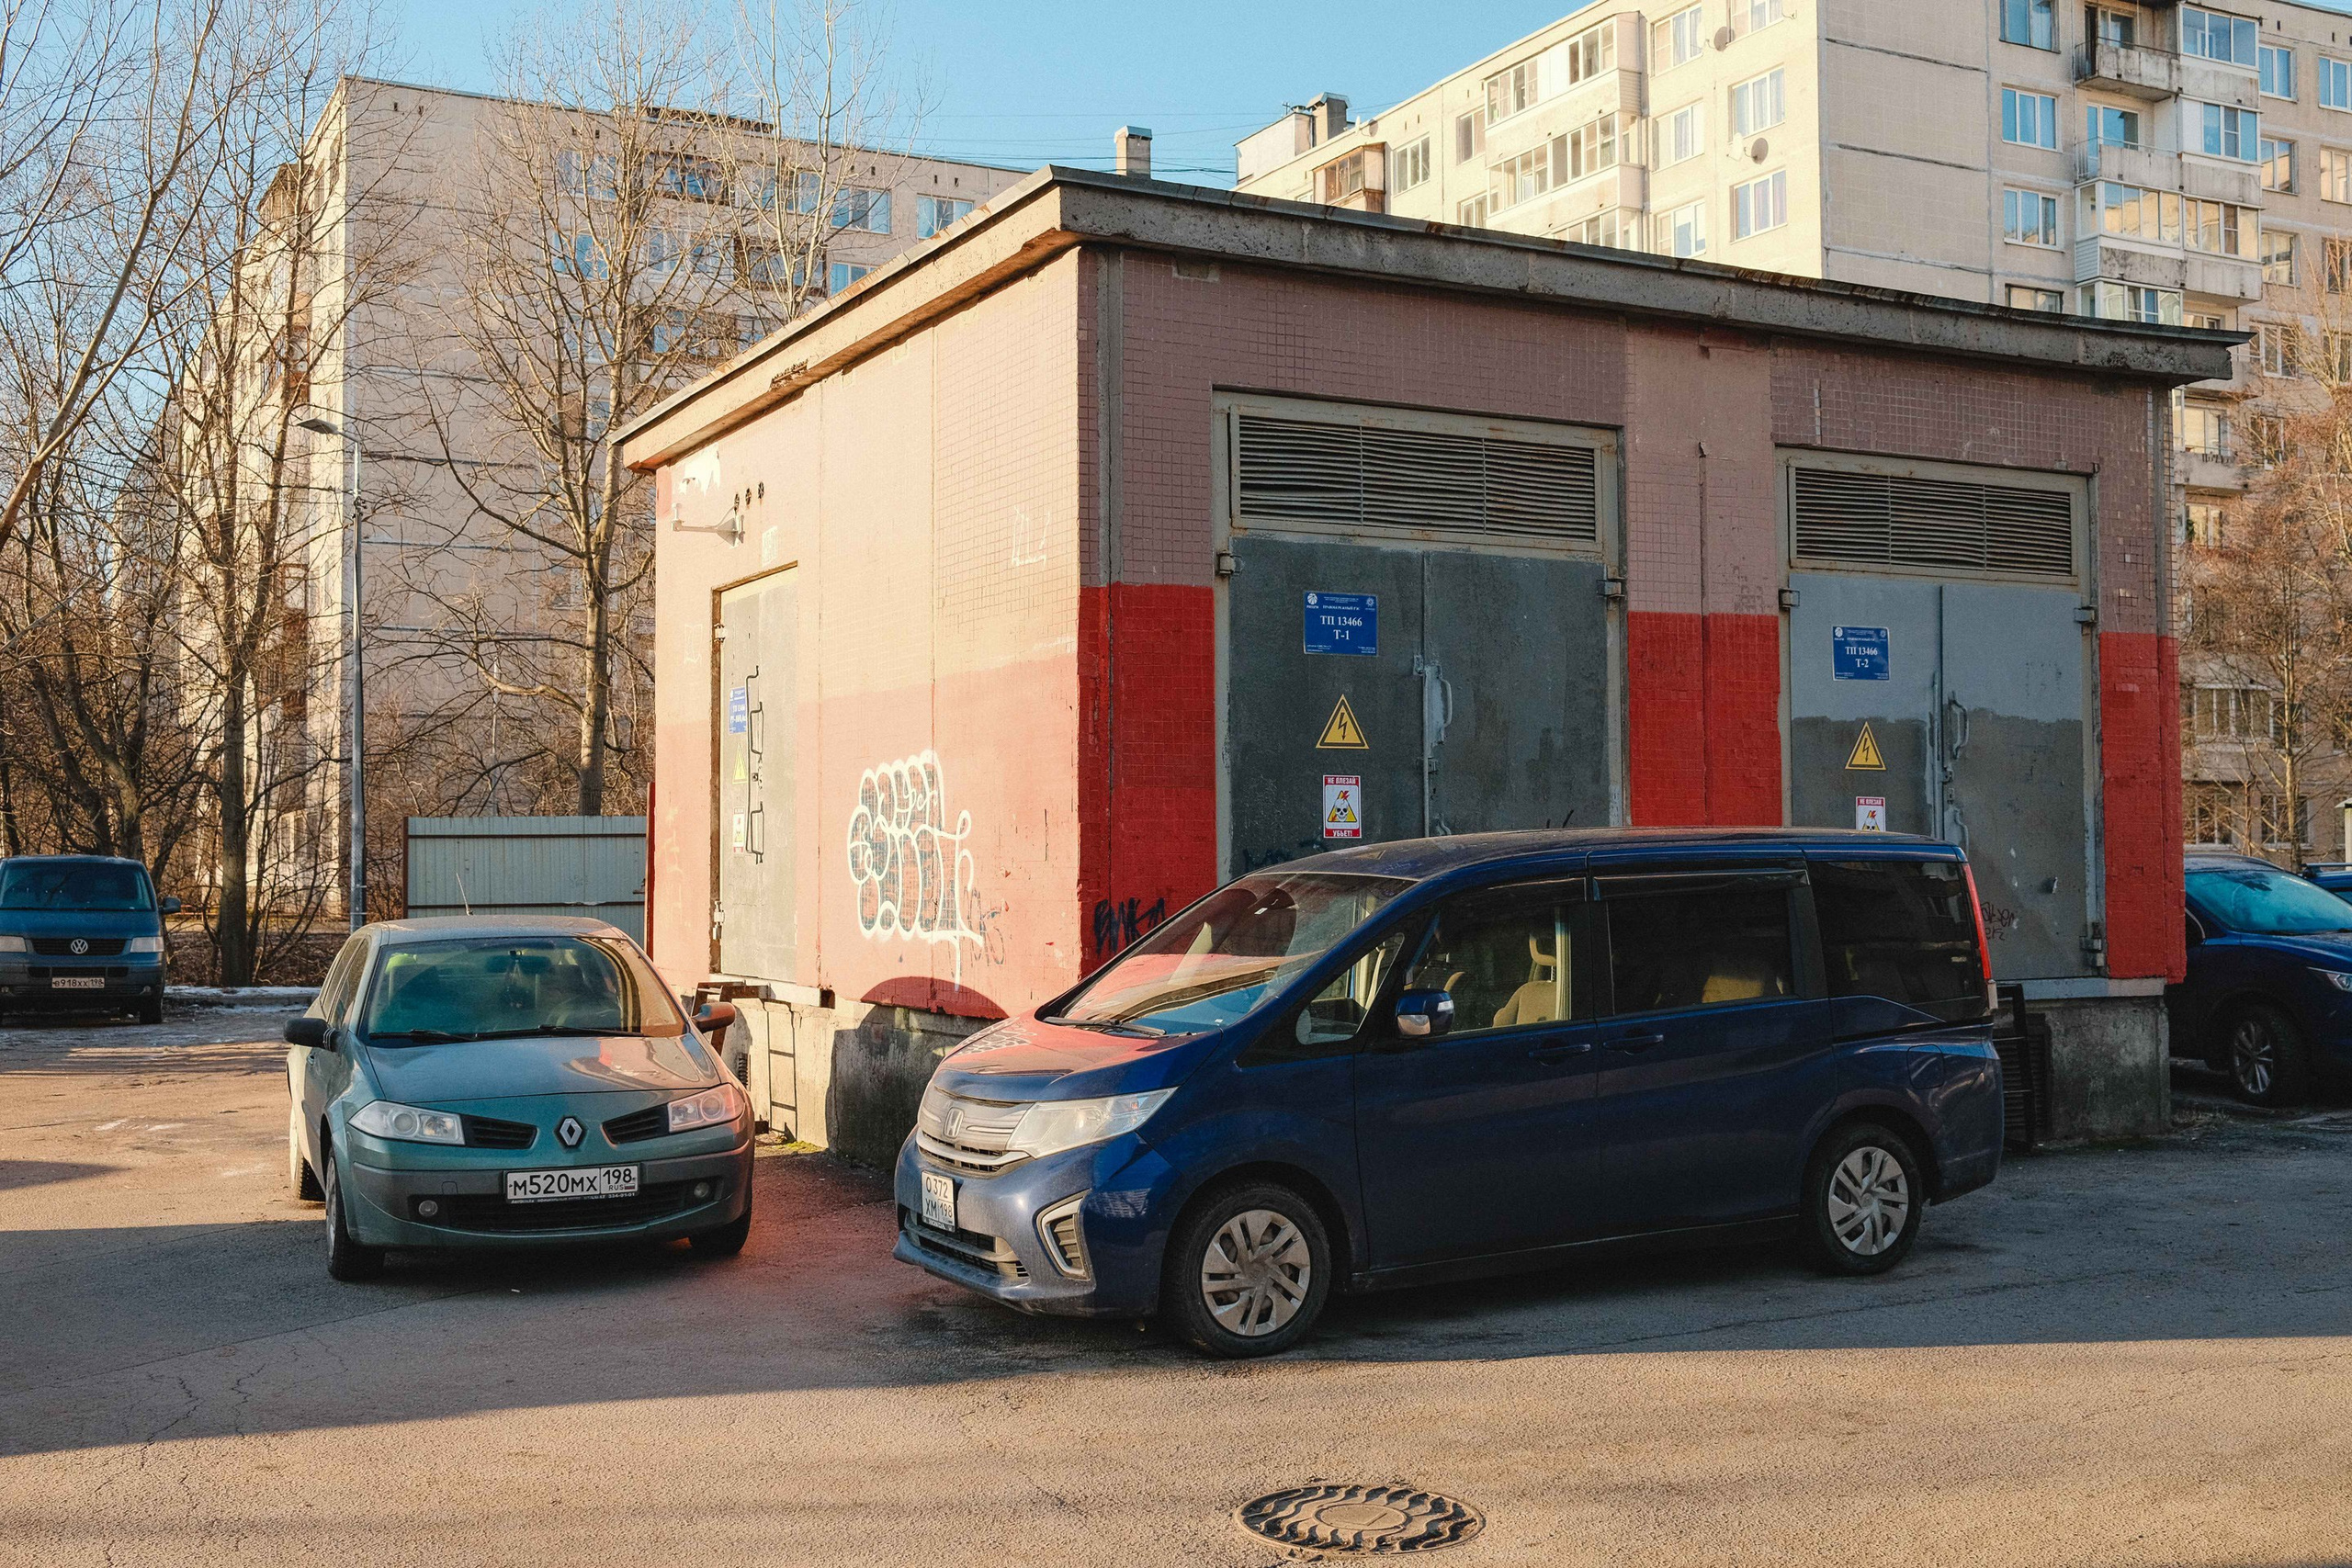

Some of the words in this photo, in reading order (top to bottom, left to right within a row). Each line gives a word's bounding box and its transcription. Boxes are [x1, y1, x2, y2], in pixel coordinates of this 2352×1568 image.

[1320, 615, 1335, 626] ТП
[1337, 616, 1363, 626] 13466
[1333, 629, 1351, 640] Т-1
[1845, 646, 1857, 655] ТП
[1859, 647, 1878, 656] 13466
[1855, 659, 1870, 668] Т-2
[1335, 776, 1356, 784] ВЛЕЗАЙ
[603, 1168, 632, 1185] 198
[925, 1198, 937, 1219] ХМ
[939, 1202, 953, 1218] 198
